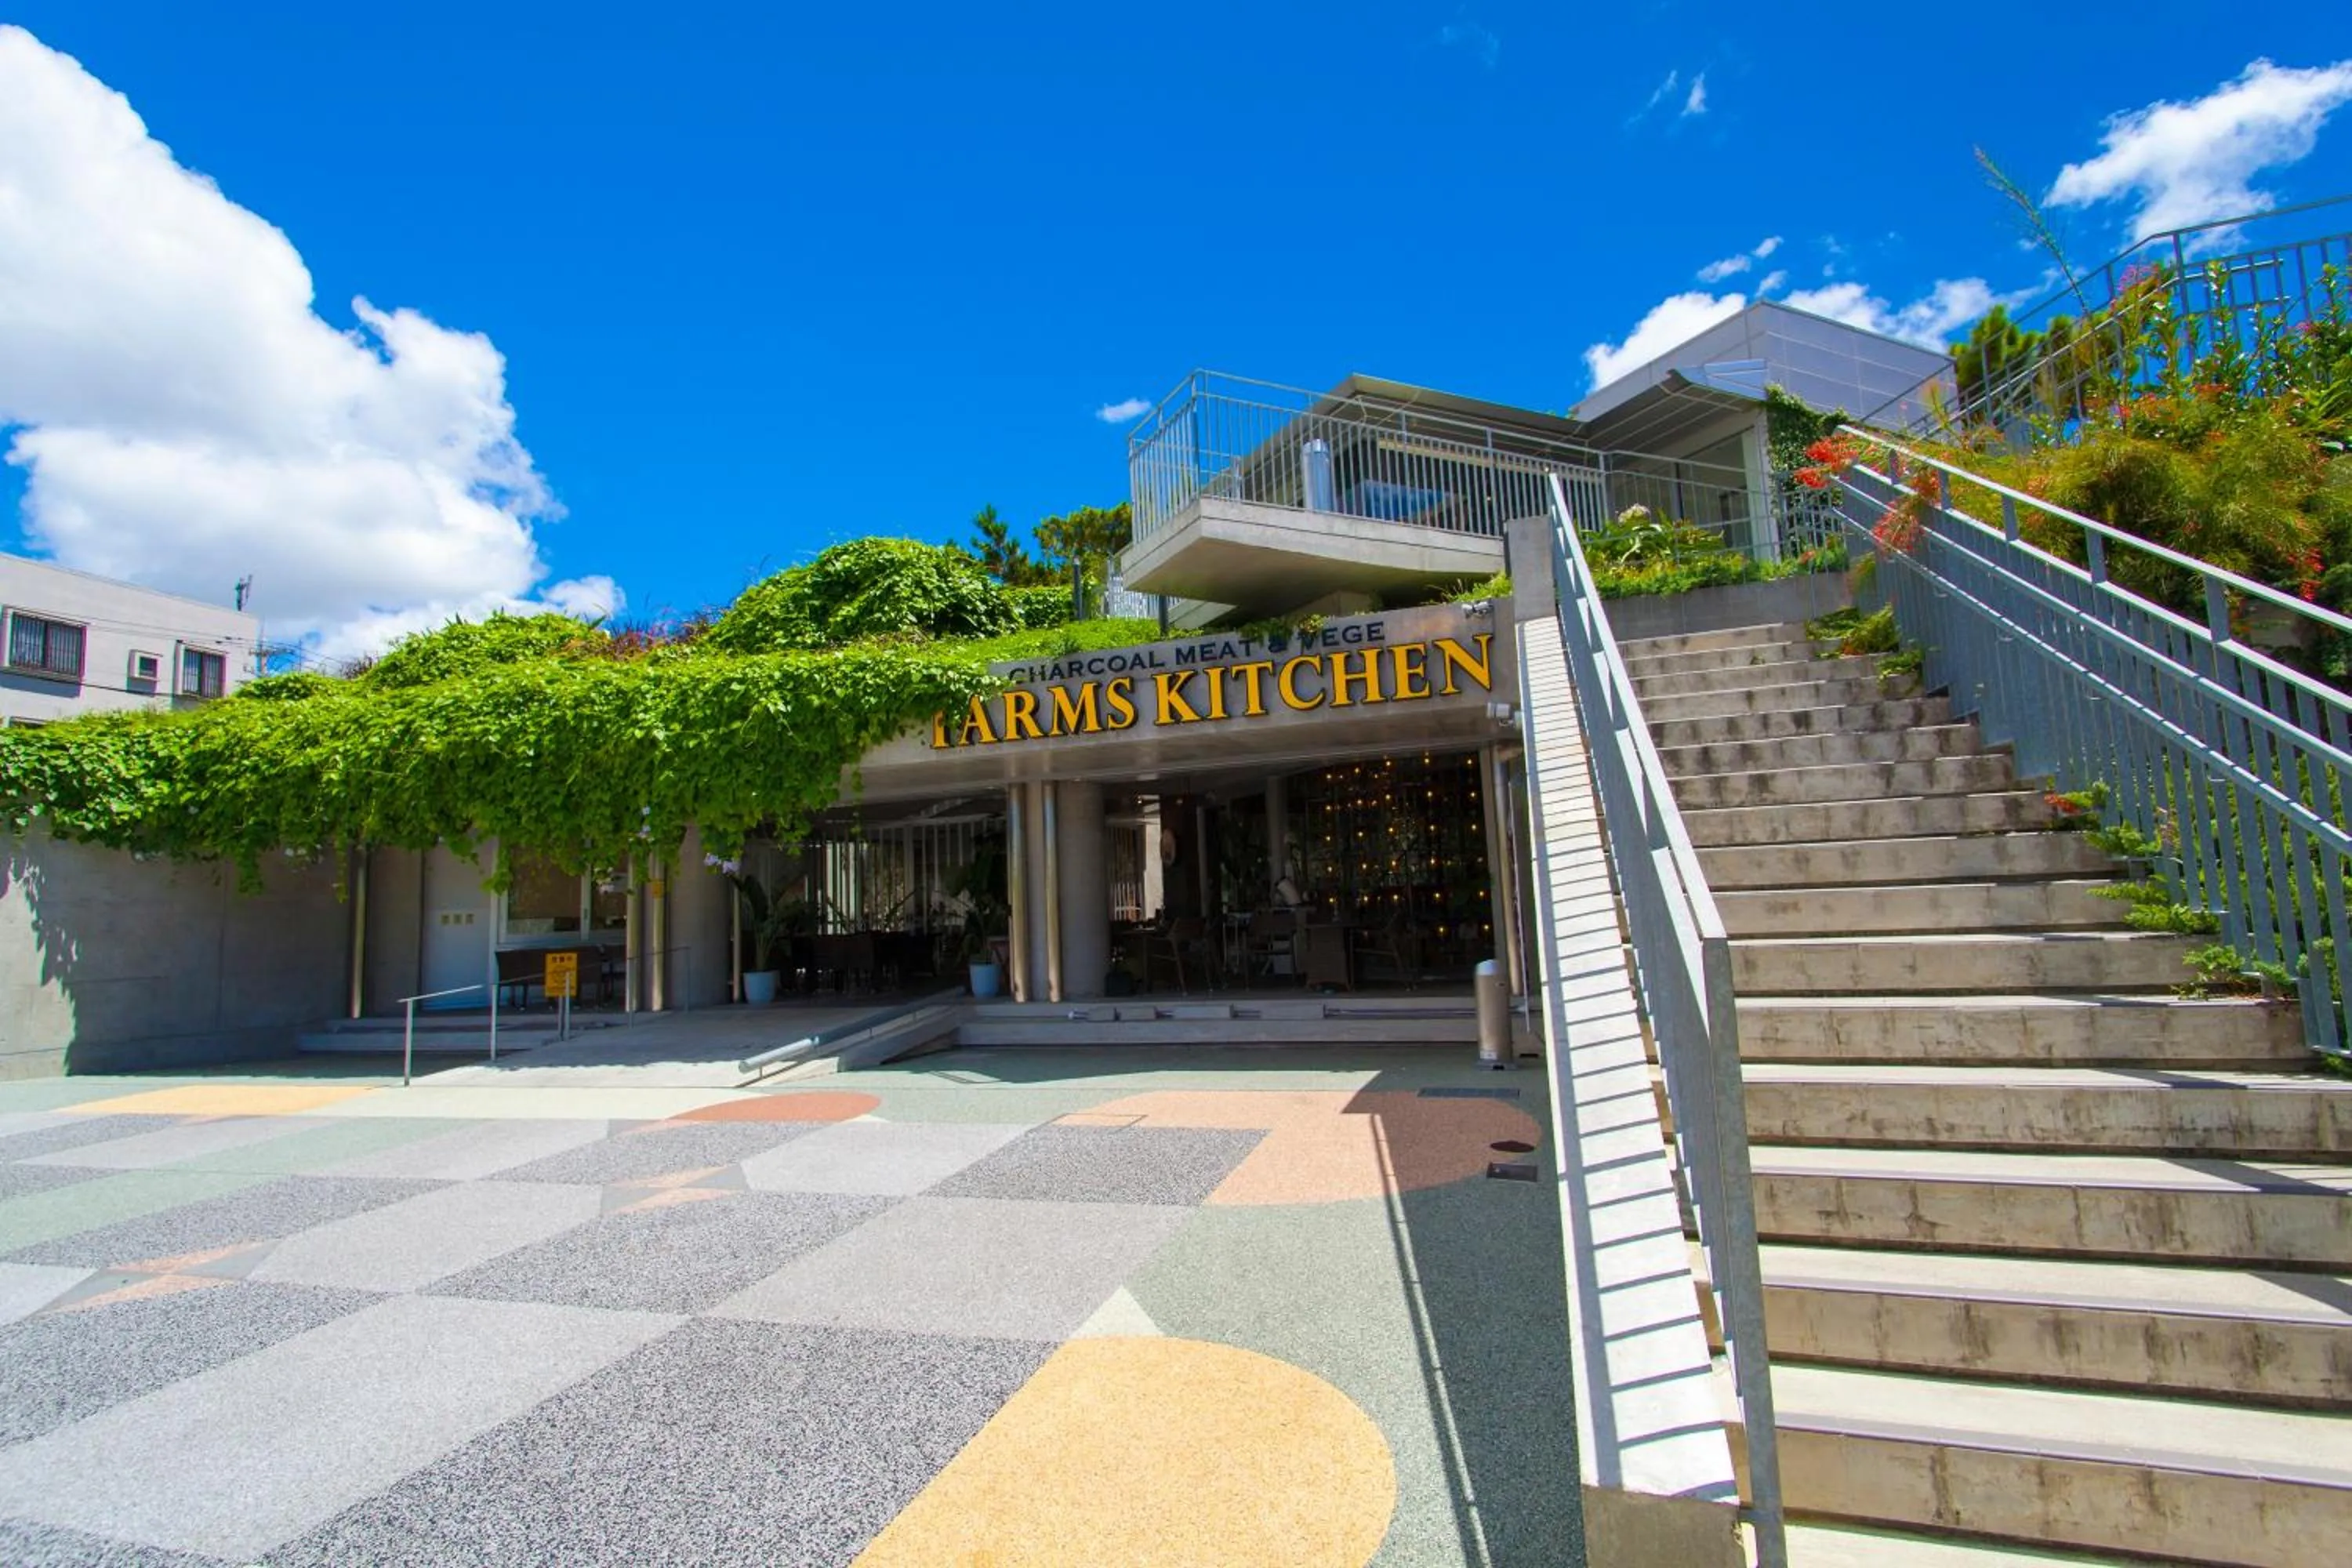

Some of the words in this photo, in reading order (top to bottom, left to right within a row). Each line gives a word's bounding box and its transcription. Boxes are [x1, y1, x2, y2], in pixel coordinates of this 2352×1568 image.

[1008, 650, 1165, 683] CHARCOAL
[1175, 639, 1252, 665] MEAT
[1152, 633, 1494, 725] KITCHEN
